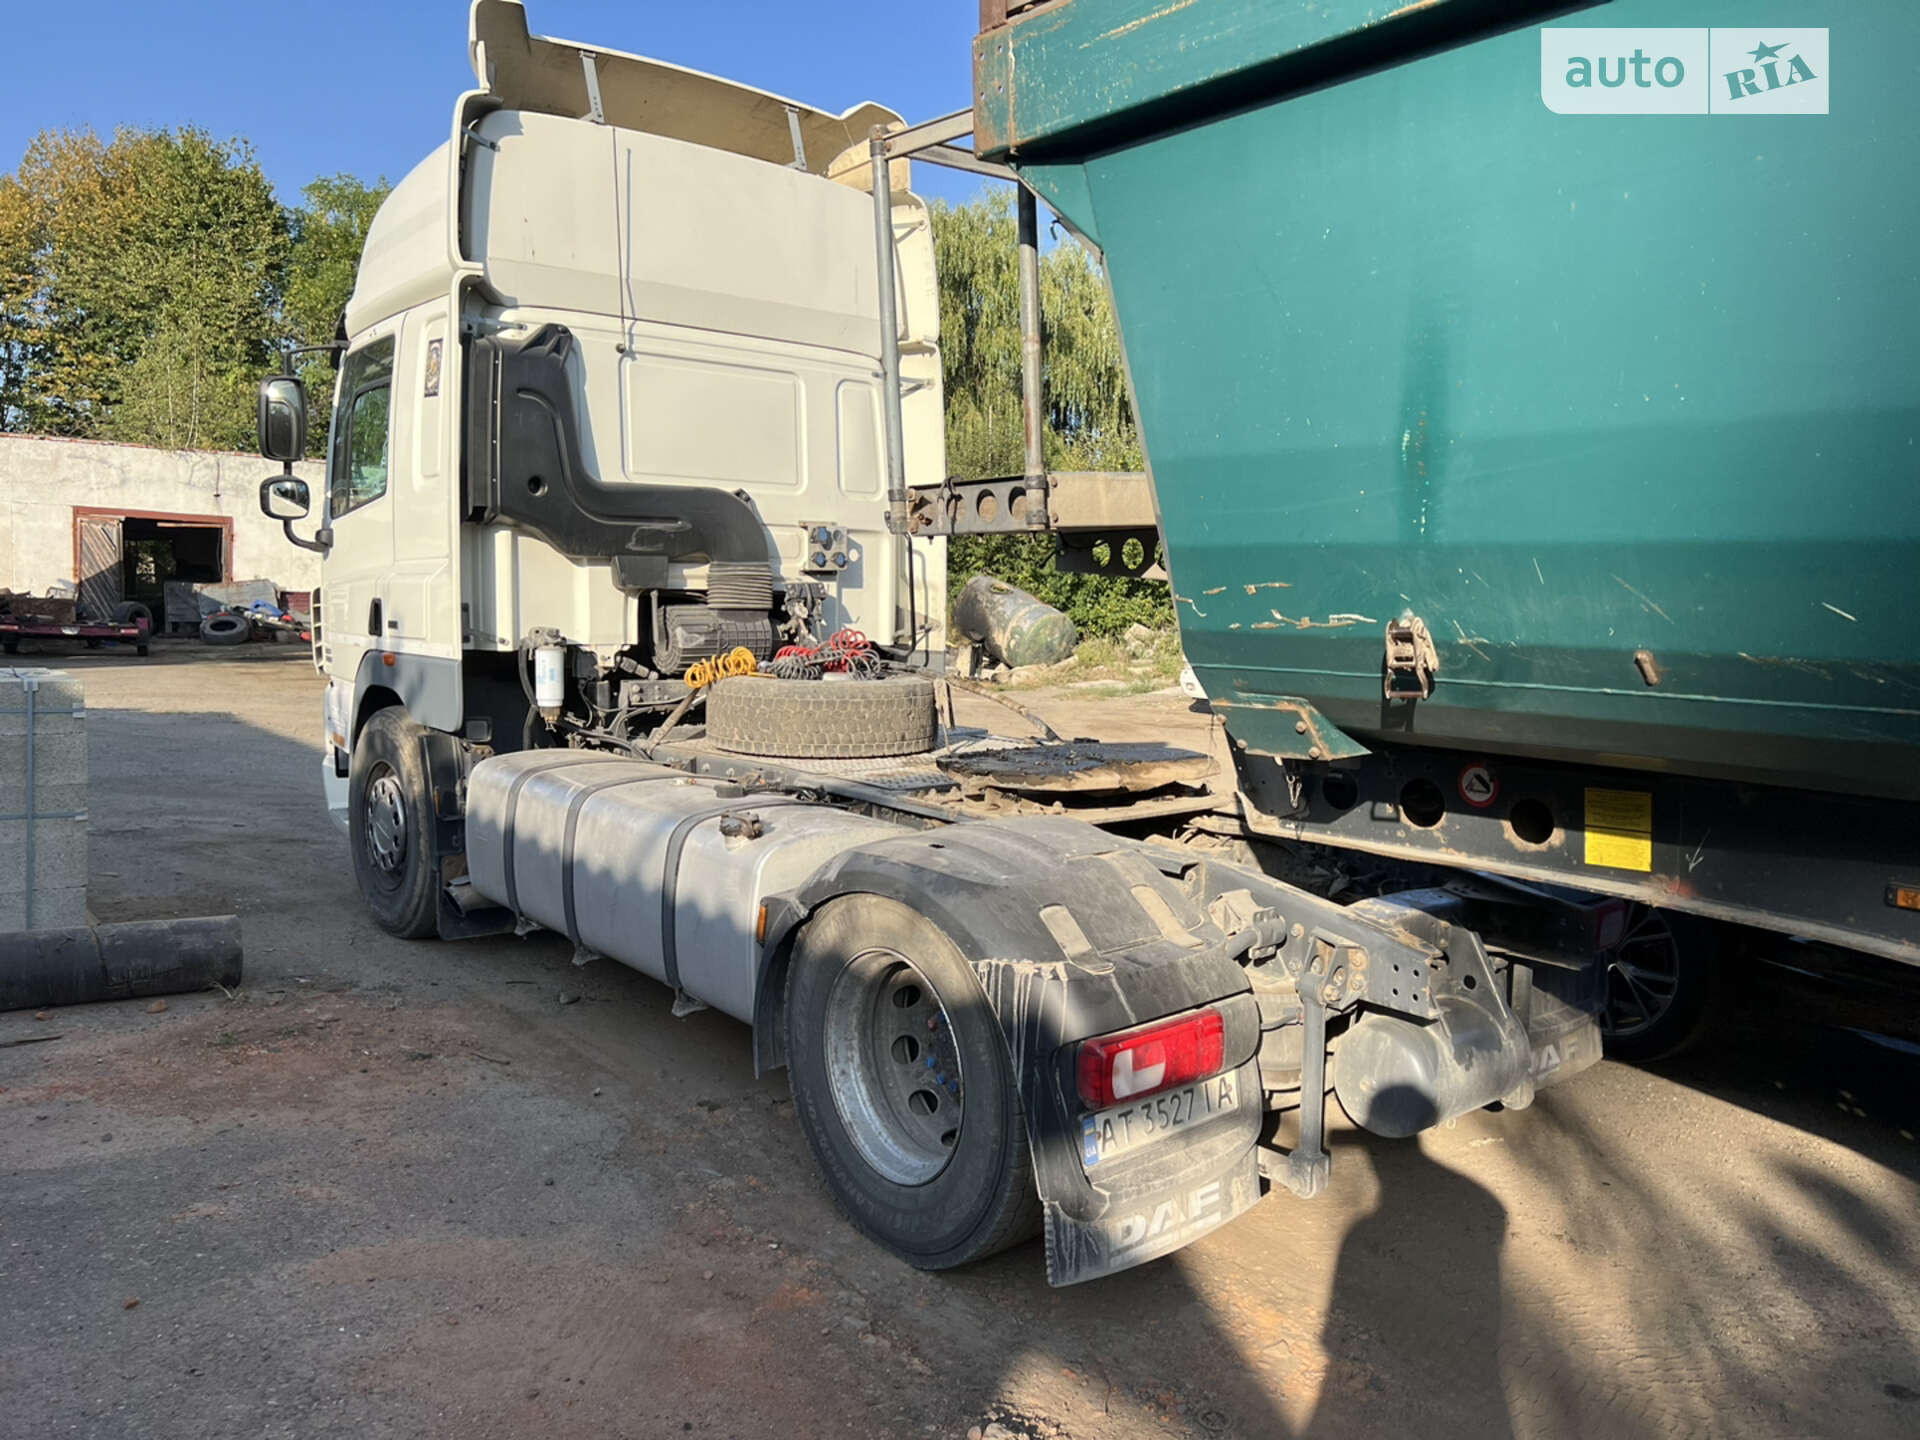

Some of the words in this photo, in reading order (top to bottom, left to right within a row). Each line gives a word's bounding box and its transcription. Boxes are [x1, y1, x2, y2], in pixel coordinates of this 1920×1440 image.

[1101, 1109, 1134, 1153] AT
[1141, 1087, 1195, 1135] 3527
[1202, 1075, 1233, 1114] IA
[1108, 1181, 1221, 1247] DAF
